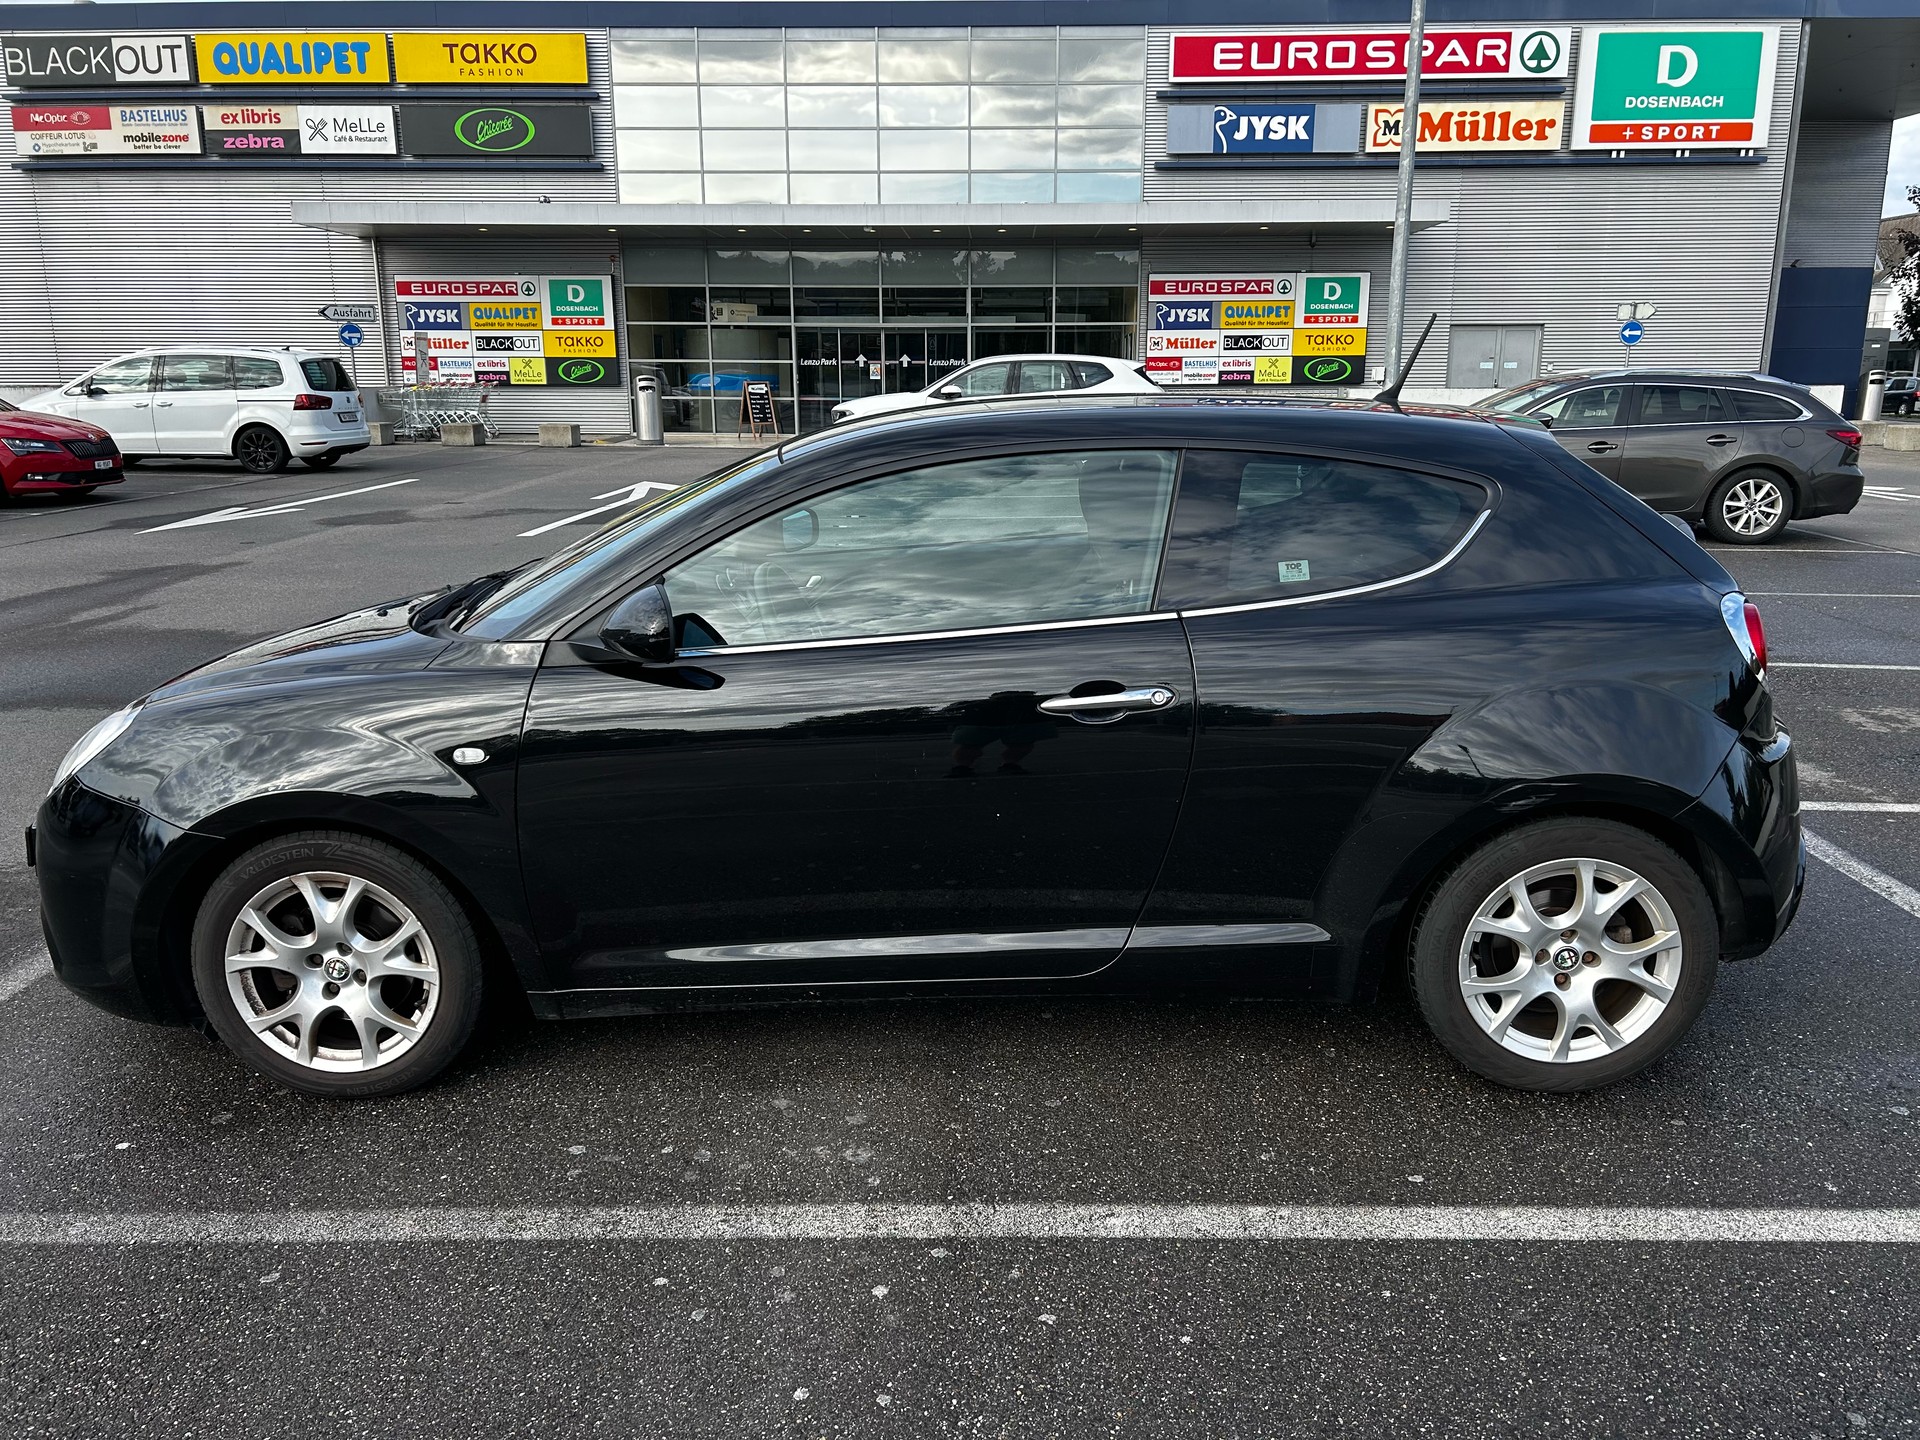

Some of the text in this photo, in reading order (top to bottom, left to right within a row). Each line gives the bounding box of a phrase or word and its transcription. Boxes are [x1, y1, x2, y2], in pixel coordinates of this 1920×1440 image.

[4, 44, 182, 76] BLACKOUT
[212, 41, 371, 75] QUALIPET
[1656, 44, 1699, 88] D
[459, 68, 525, 77] FASHION
[1624, 95, 1724, 109] DOSENBACH
[30, 112, 68, 124] McOptic
[120, 109, 188, 122] BASTELHUS
[220, 108, 281, 124] ex libris
[333, 117, 386, 133] MeLLe
[1232, 115, 1310, 140] JYSK
[1416, 110, 1557, 143] Müller
[30, 132, 86, 140] COIFFEUR LOTUS
[123, 132, 189, 143] mobilezone
[223, 133, 285, 148] zebra
[354, 135, 388, 143] Restaurant
[411, 283, 518, 294] EUROSPAR
[1164, 281, 1273, 293] EUROSPAR
[332, 308, 372, 318] Ausfahrt
[417, 309, 460, 323] JYSK
[473, 306, 538, 320] QUALIPET
[1167, 308, 1210, 322] JYSK
[1224, 305, 1291, 318] QUALIPET
[476, 338, 538, 349] BLACKOUT
[1166, 337, 1217, 349] Müller
[1224, 337, 1287, 348] BLACKOUT
[800, 358, 838, 366] Lenzo Park
[928, 358, 967, 366] Lenzo Park
[1232, 359, 1252, 367] libris
[514, 370, 542, 378] MeLLe
[1221, 372, 1251, 380] zebra
[1285, 562, 1302, 570] TOP
